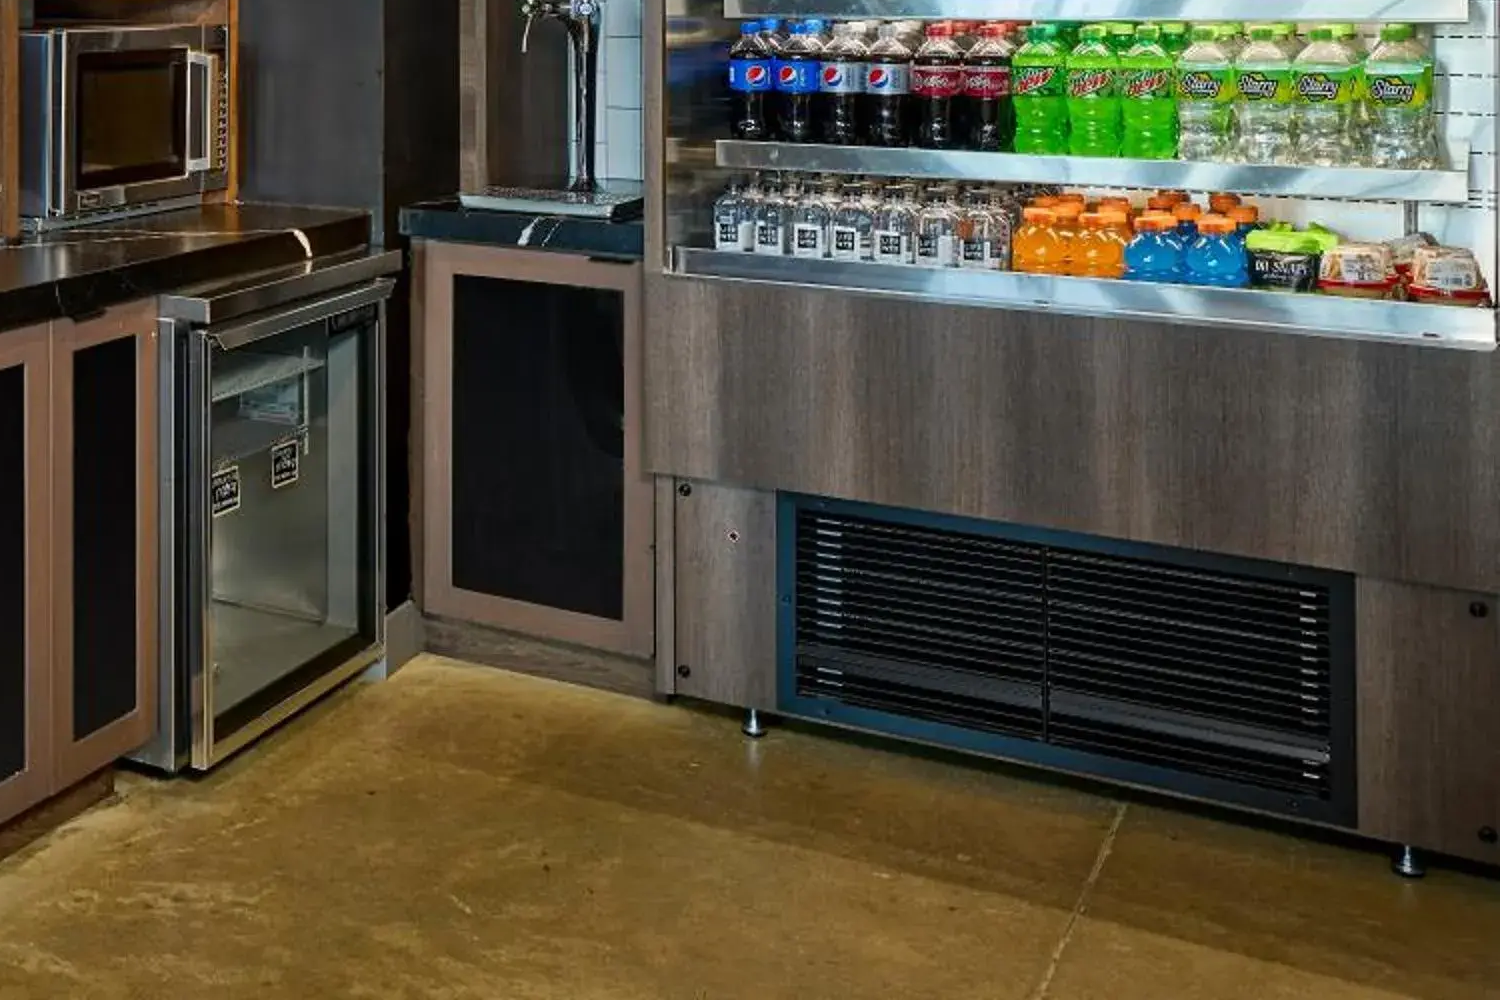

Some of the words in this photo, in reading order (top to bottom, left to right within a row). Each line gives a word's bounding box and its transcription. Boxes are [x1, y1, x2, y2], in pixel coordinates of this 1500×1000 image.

[1184, 73, 1220, 96] Starry
[1240, 74, 1277, 97] Starry
[1301, 74, 1338, 98] Starry
[1373, 77, 1413, 101] Starry
